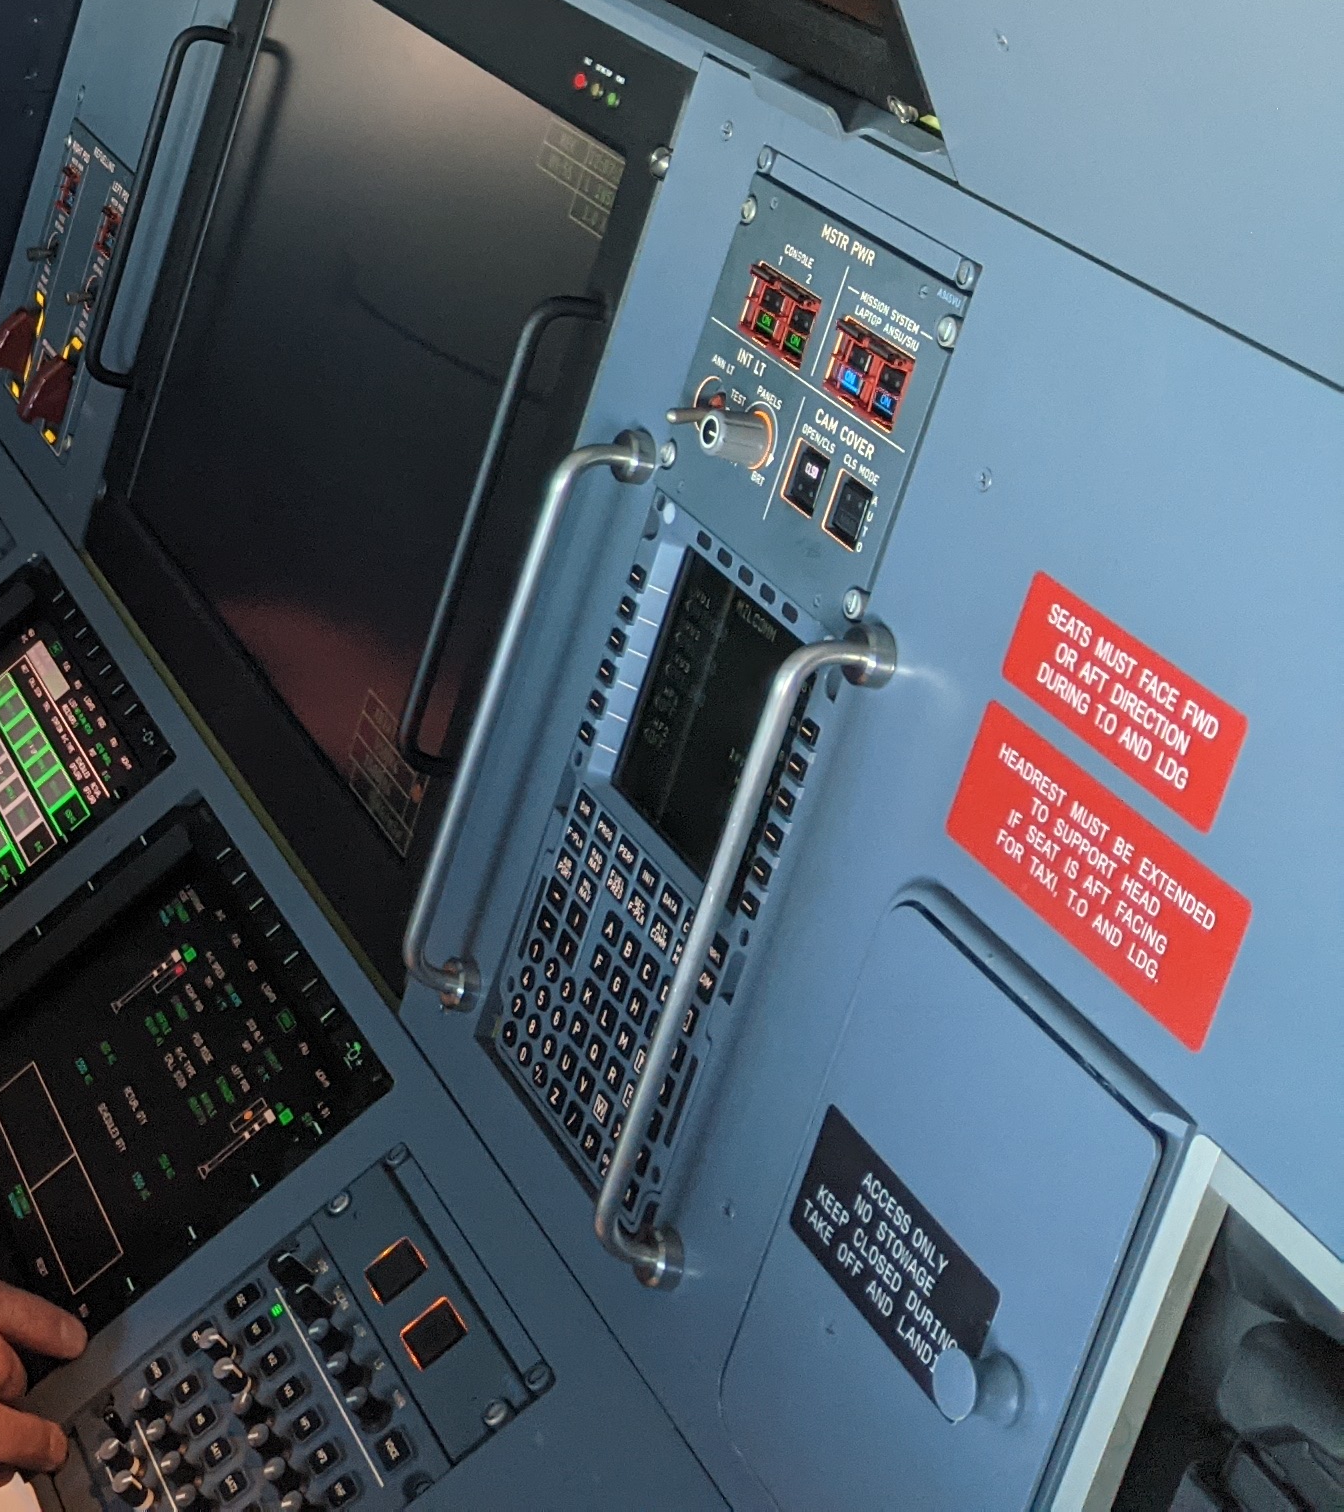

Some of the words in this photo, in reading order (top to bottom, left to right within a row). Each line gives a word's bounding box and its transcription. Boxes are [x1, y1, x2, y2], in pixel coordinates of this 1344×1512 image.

[821, 224, 849, 251] MSTR
[850, 241, 876, 267] PWR
[784, 244, 814, 269] CONSOLE
[806, 274, 812, 284] 2
[762, 314, 770, 327] ON
[855, 305, 882, 327] LAPTOP
[861, 292, 893, 319] MISSION
[890, 309, 920, 335] SYSTEM
[790, 335, 800, 348] ON
[726, 363, 736, 376] LT
[736, 348, 753, 369] INT
[753, 359, 767, 377] LT
[844, 371, 856, 385] ON
[730, 388, 747, 406] TEST
[756, 386, 783, 410] PANELS
[880, 395, 892, 407] ON
[802, 423, 836, 454] OPEN/CLS
[815, 408, 837, 434] CAM
[839, 426, 875, 461] COVER
[843, 454, 859, 472] CLS
[858, 463, 880, 485] MODE
[1048, 604, 1092, 647] SEATS
[1094, 637, 1138, 679] MUST
[1138, 669, 1180, 712] FACE
[1182, 700, 1219, 739] FWD
[1055, 643, 1078, 672] OR
[1079, 662, 1109, 693] AFT
[1110, 683, 1191, 756] DIRECTION
[1037, 662, 1091, 715] DURING
[1094, 704, 1117, 735] T.O
[1119, 727, 1152, 762] AND
[1154, 751, 1189, 790] LDG
[998, 743, 1067, 807] HEADREST
[1070, 801, 1110, 842] MUST
[1113, 836, 1135, 865] BE
[1139, 857, 1216, 931] EXTENDED
[1030, 797, 1049, 823] TO
[1054, 819, 1118, 879] SUPPORT
[1121, 874, 1160, 917] HEAD
[1007, 809, 1023, 828] IF
[1026, 825, 1061, 862] SEAT
[1064, 857, 1079, 879] IS
[1083, 876, 1112, 905] AFT
[1115, 900, 1167, 955] FACING
[663, 893, 678, 915] DATA
[996, 829, 1024, 863] FOR
[1028, 856, 1058, 897] TAXI,
[1066, 888, 1088, 917] T.O
[1092, 914, 1122, 947] AND
[1127, 943, 1158, 983] LDG.
[605, 922, 614, 938] A
[533, 944, 539, 957] 1
[623, 942, 633, 958] B
[593, 954, 604, 968] F
[523, 972, 529, 986] 4
[546, 963, 554, 978] 2
[642, 964, 651, 979] C
[563, 983, 570, 996] 3
[613, 977, 621, 992] G
[538, 990, 545, 1006] 5
[582, 988, 592, 1005] K
[514, 999, 521, 1012] 7
[630, 998, 640, 1016] H
[529, 1019, 536, 1033] 8
[553, 1012, 560, 1026] 6
[600, 1010, 608, 1026] L
[572, 1021, 581, 1034] P
[544, 1040, 551, 1054] 9
[618, 1032, 629, 1049] M
[562, 1054, 570, 1071] U
[590, 1047, 598, 1061] Q
[607, 1066, 617, 1083] R
[580, 1076, 588, 1092] V
[550, 1090, 559, 1105] Z
[862, 1172, 911, 1234] ACCESS
[912, 1228, 949, 1274] ONLY
[817, 1184, 849, 1227] KEEP
[853, 1228, 902, 1293] CLOSED
[854, 1194, 872, 1223] NO
[877, 1222, 935, 1297] STOWAGE
[803, 1199, 835, 1246] TAKE
[837, 1243, 864, 1277] OFF
[866, 1281, 893, 1317] AND
[897, 1315, 939, 1373] LANDI
